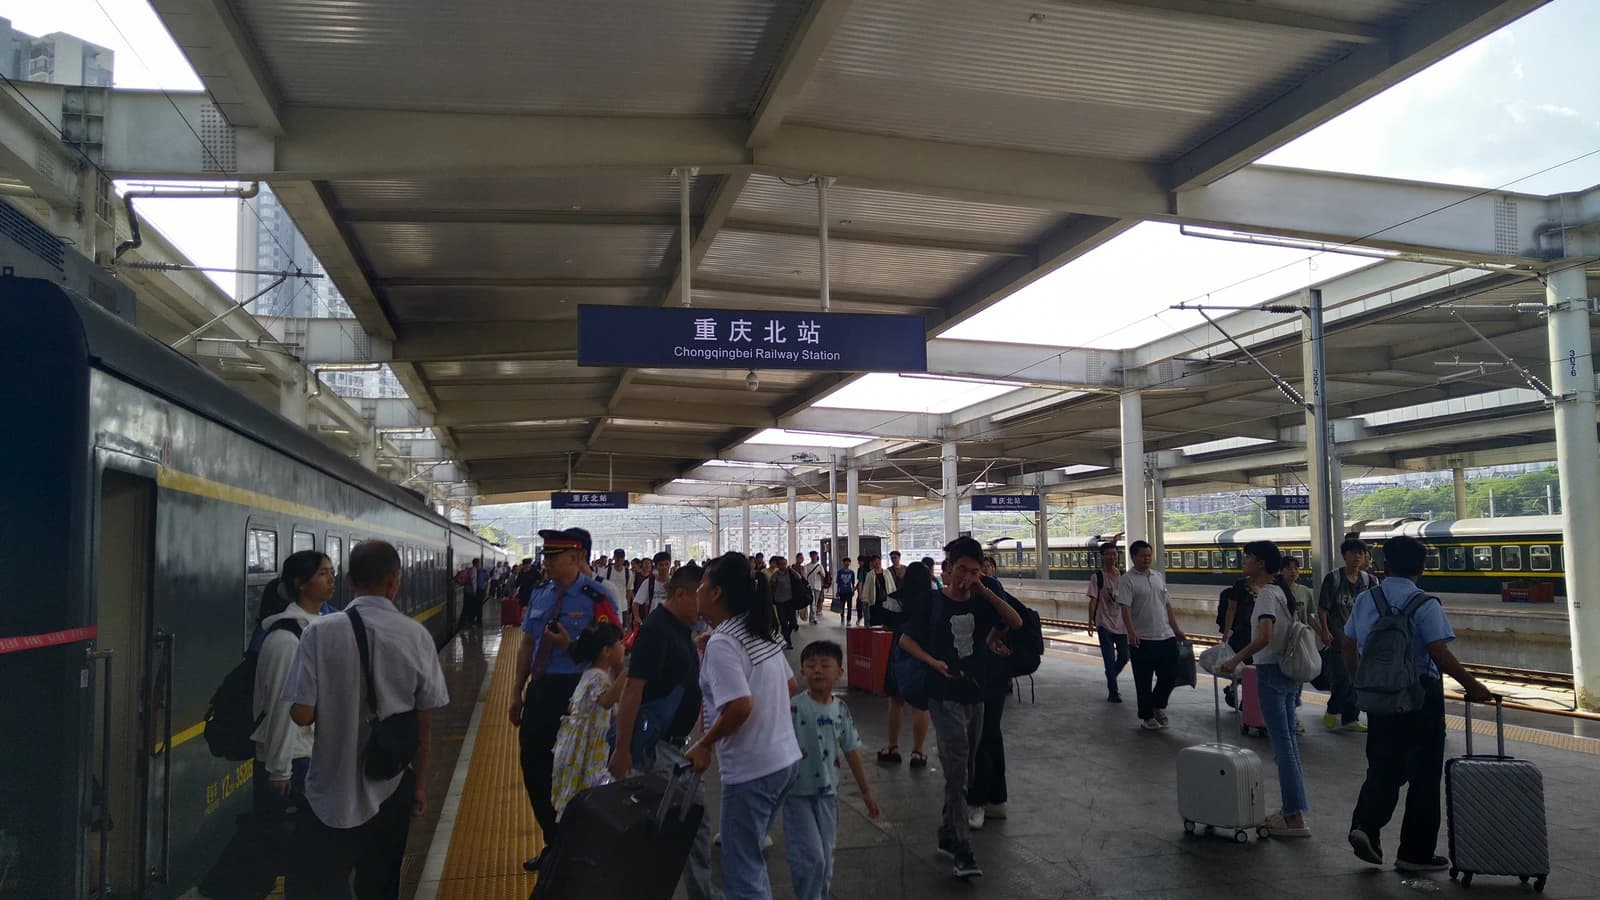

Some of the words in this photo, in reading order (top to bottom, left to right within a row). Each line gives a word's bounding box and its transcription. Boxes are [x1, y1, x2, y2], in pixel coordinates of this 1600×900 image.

[693, 318, 821, 344] 重庆北站
[673, 346, 753, 361] Chongqingbei
[755, 349, 800, 362] Railway
[802, 350, 840, 361] Station
[1569, 349, 1577, 377] 3076
[573, 494, 607, 502] 重庆北站
[991, 497, 1021, 505] 重庆北站
